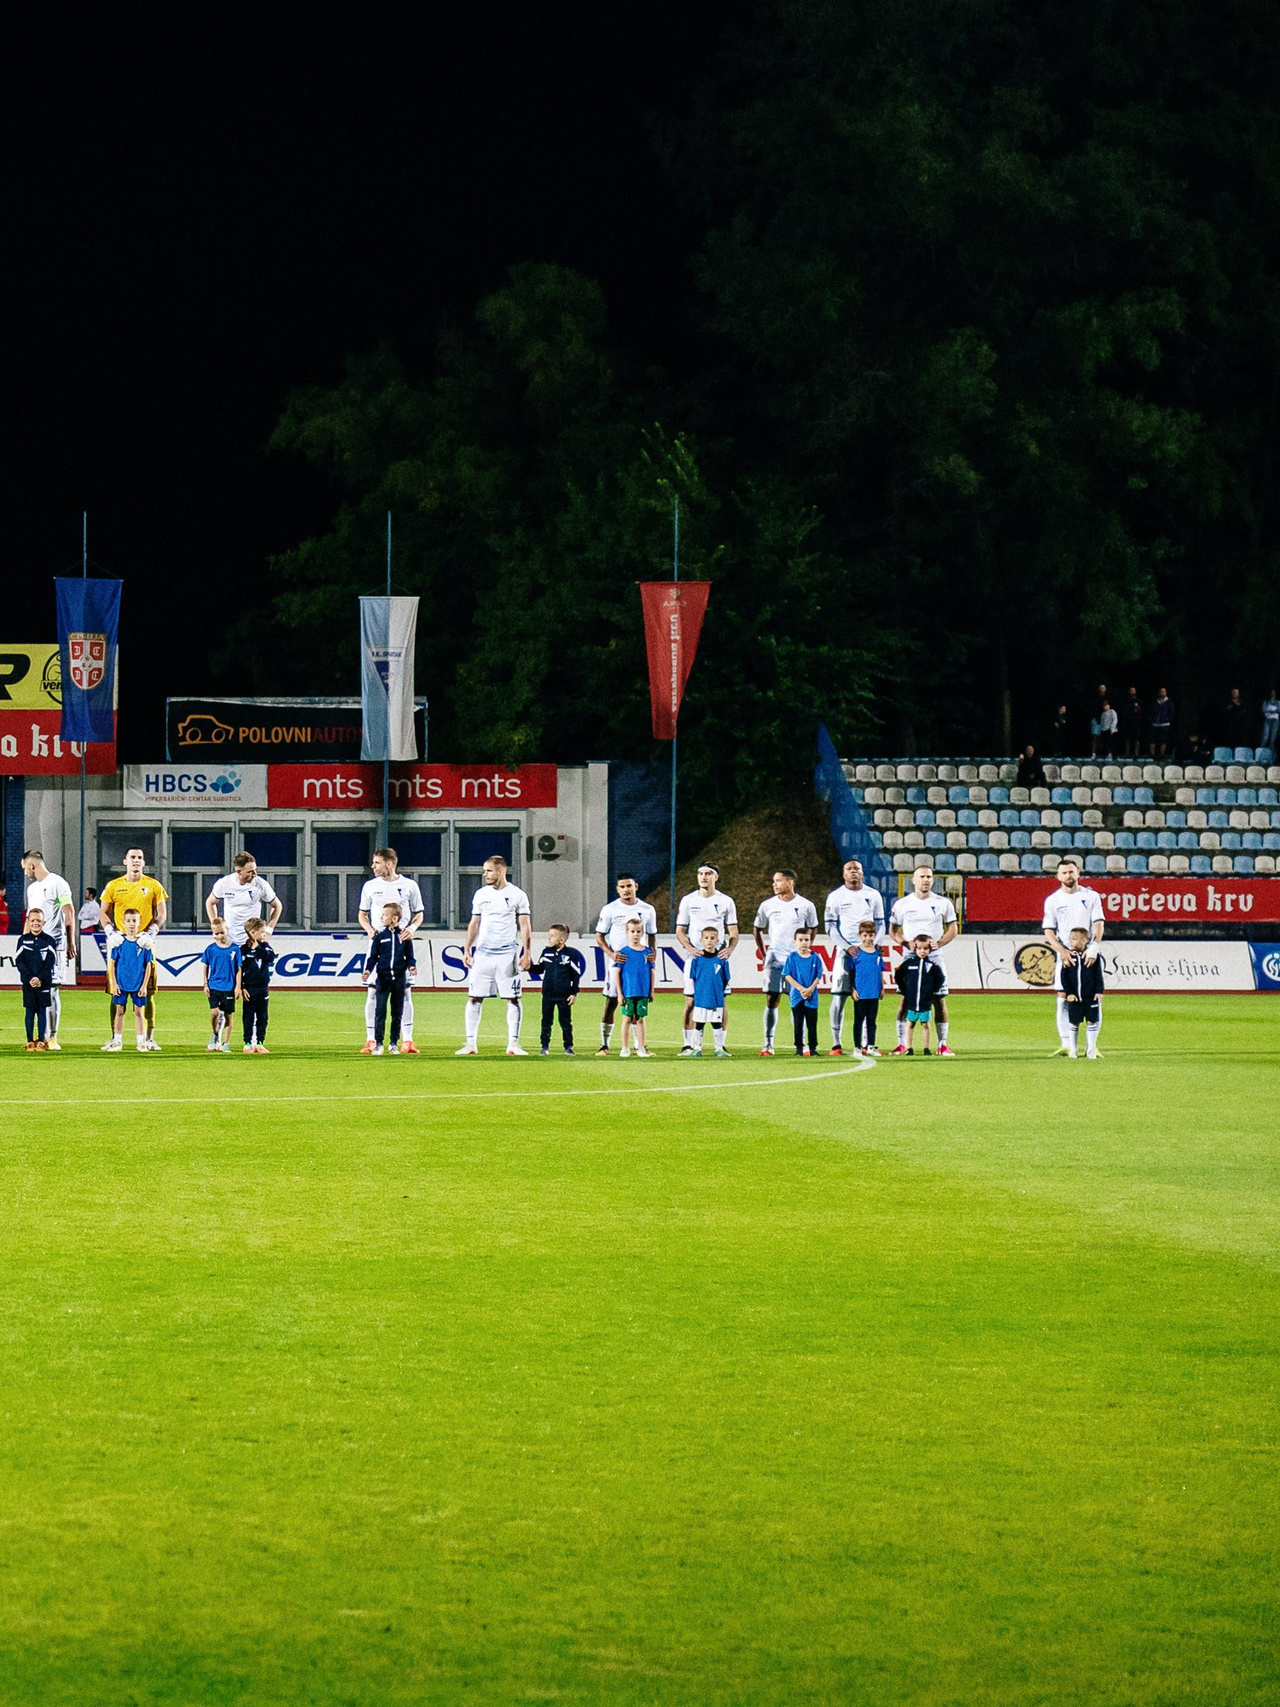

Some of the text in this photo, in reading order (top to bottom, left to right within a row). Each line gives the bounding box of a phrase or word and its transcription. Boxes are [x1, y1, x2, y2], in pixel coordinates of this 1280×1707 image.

[145, 773, 207, 793] HBCS
[303, 774, 521, 799] mts mts mts
[1207, 884, 1254, 912] krv
